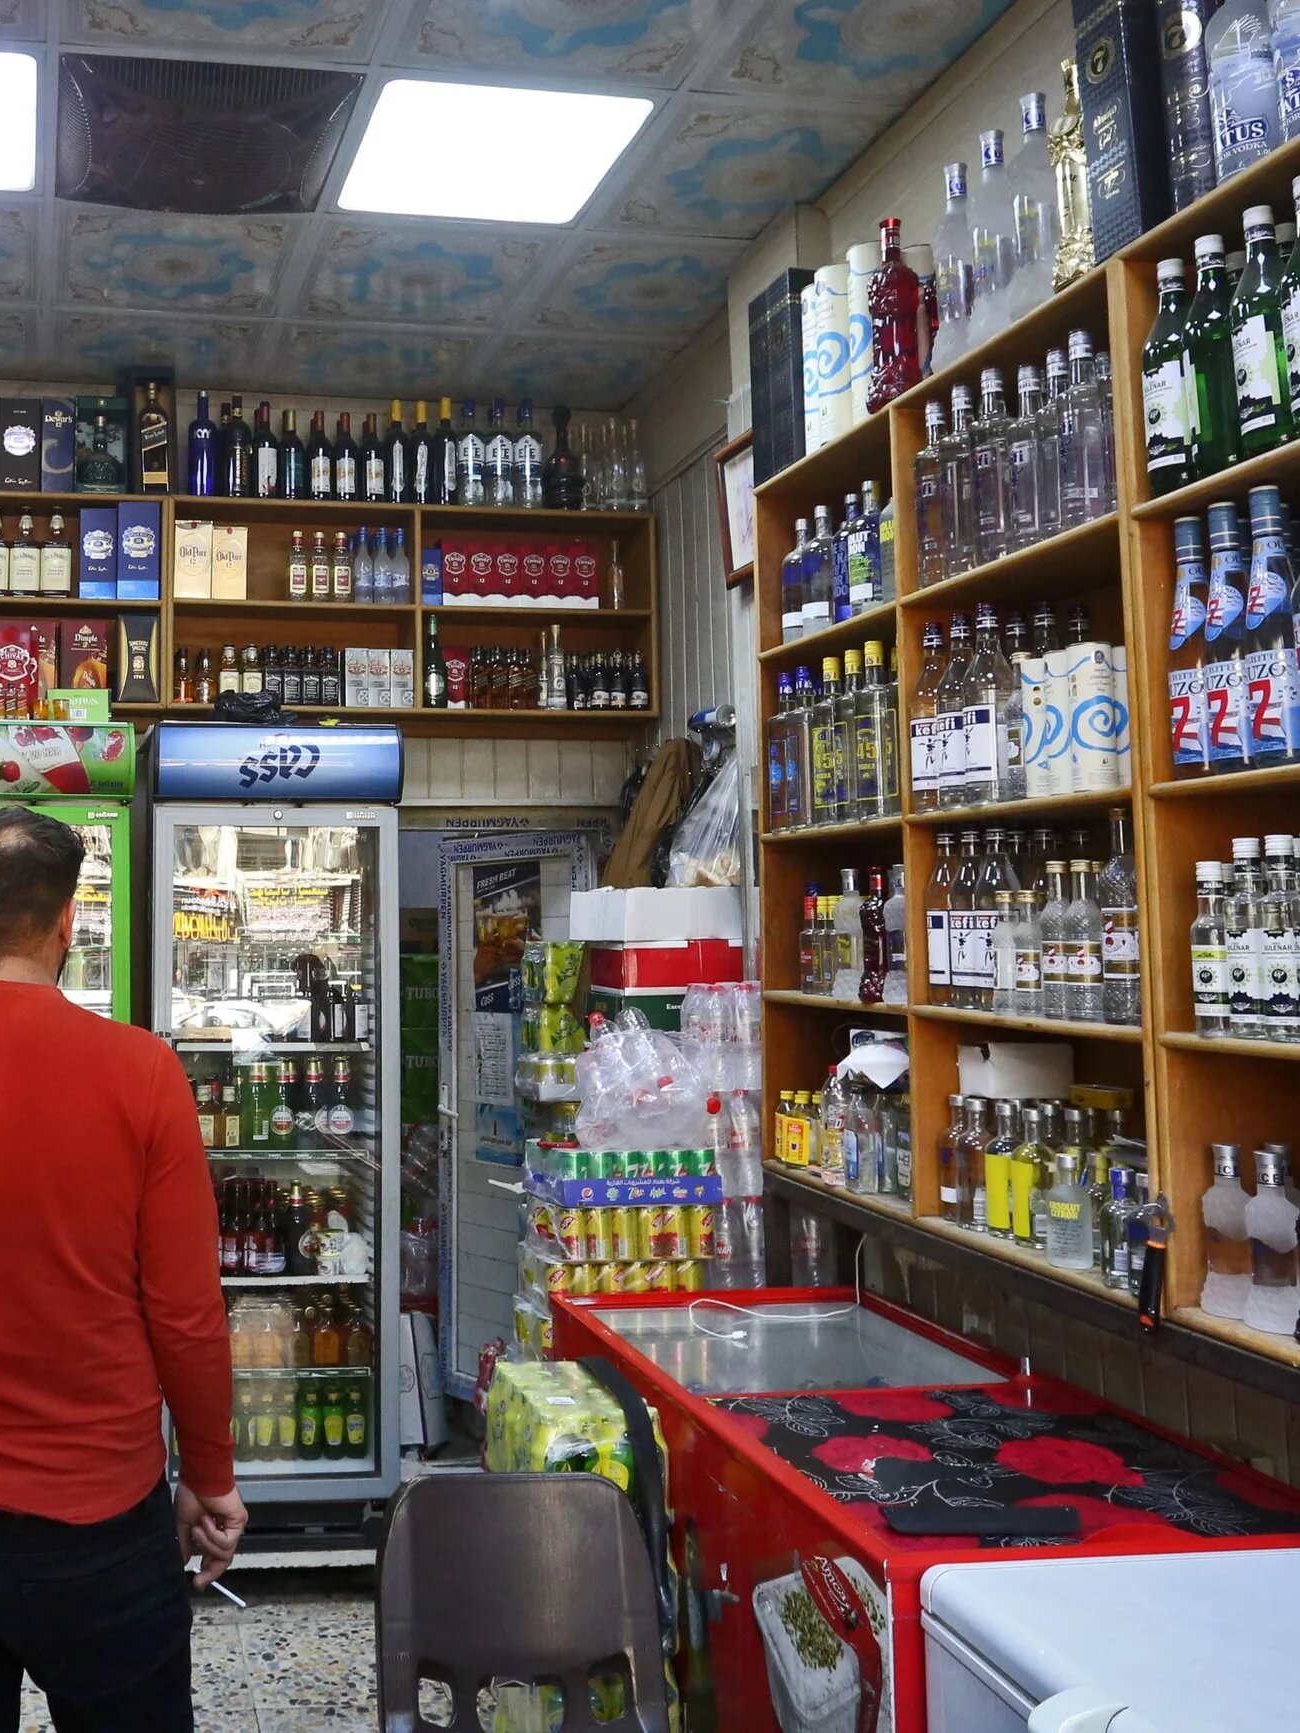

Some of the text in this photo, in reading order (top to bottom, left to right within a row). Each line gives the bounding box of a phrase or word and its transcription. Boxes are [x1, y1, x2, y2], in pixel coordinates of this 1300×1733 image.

[1232, 140, 1267, 156] VODKA
[1206, 671, 1244, 691] UZO
[1247, 662, 1287, 681] UZO
[1169, 677, 1204, 698] UZO
[1208, 690, 1228, 747] 7
[1249, 679, 1271, 740] 7
[914, 723, 938, 737] kef
[937, 717, 956, 731] efi
[1171, 696, 1190, 751] 7
[977, 917, 998, 929] kef
